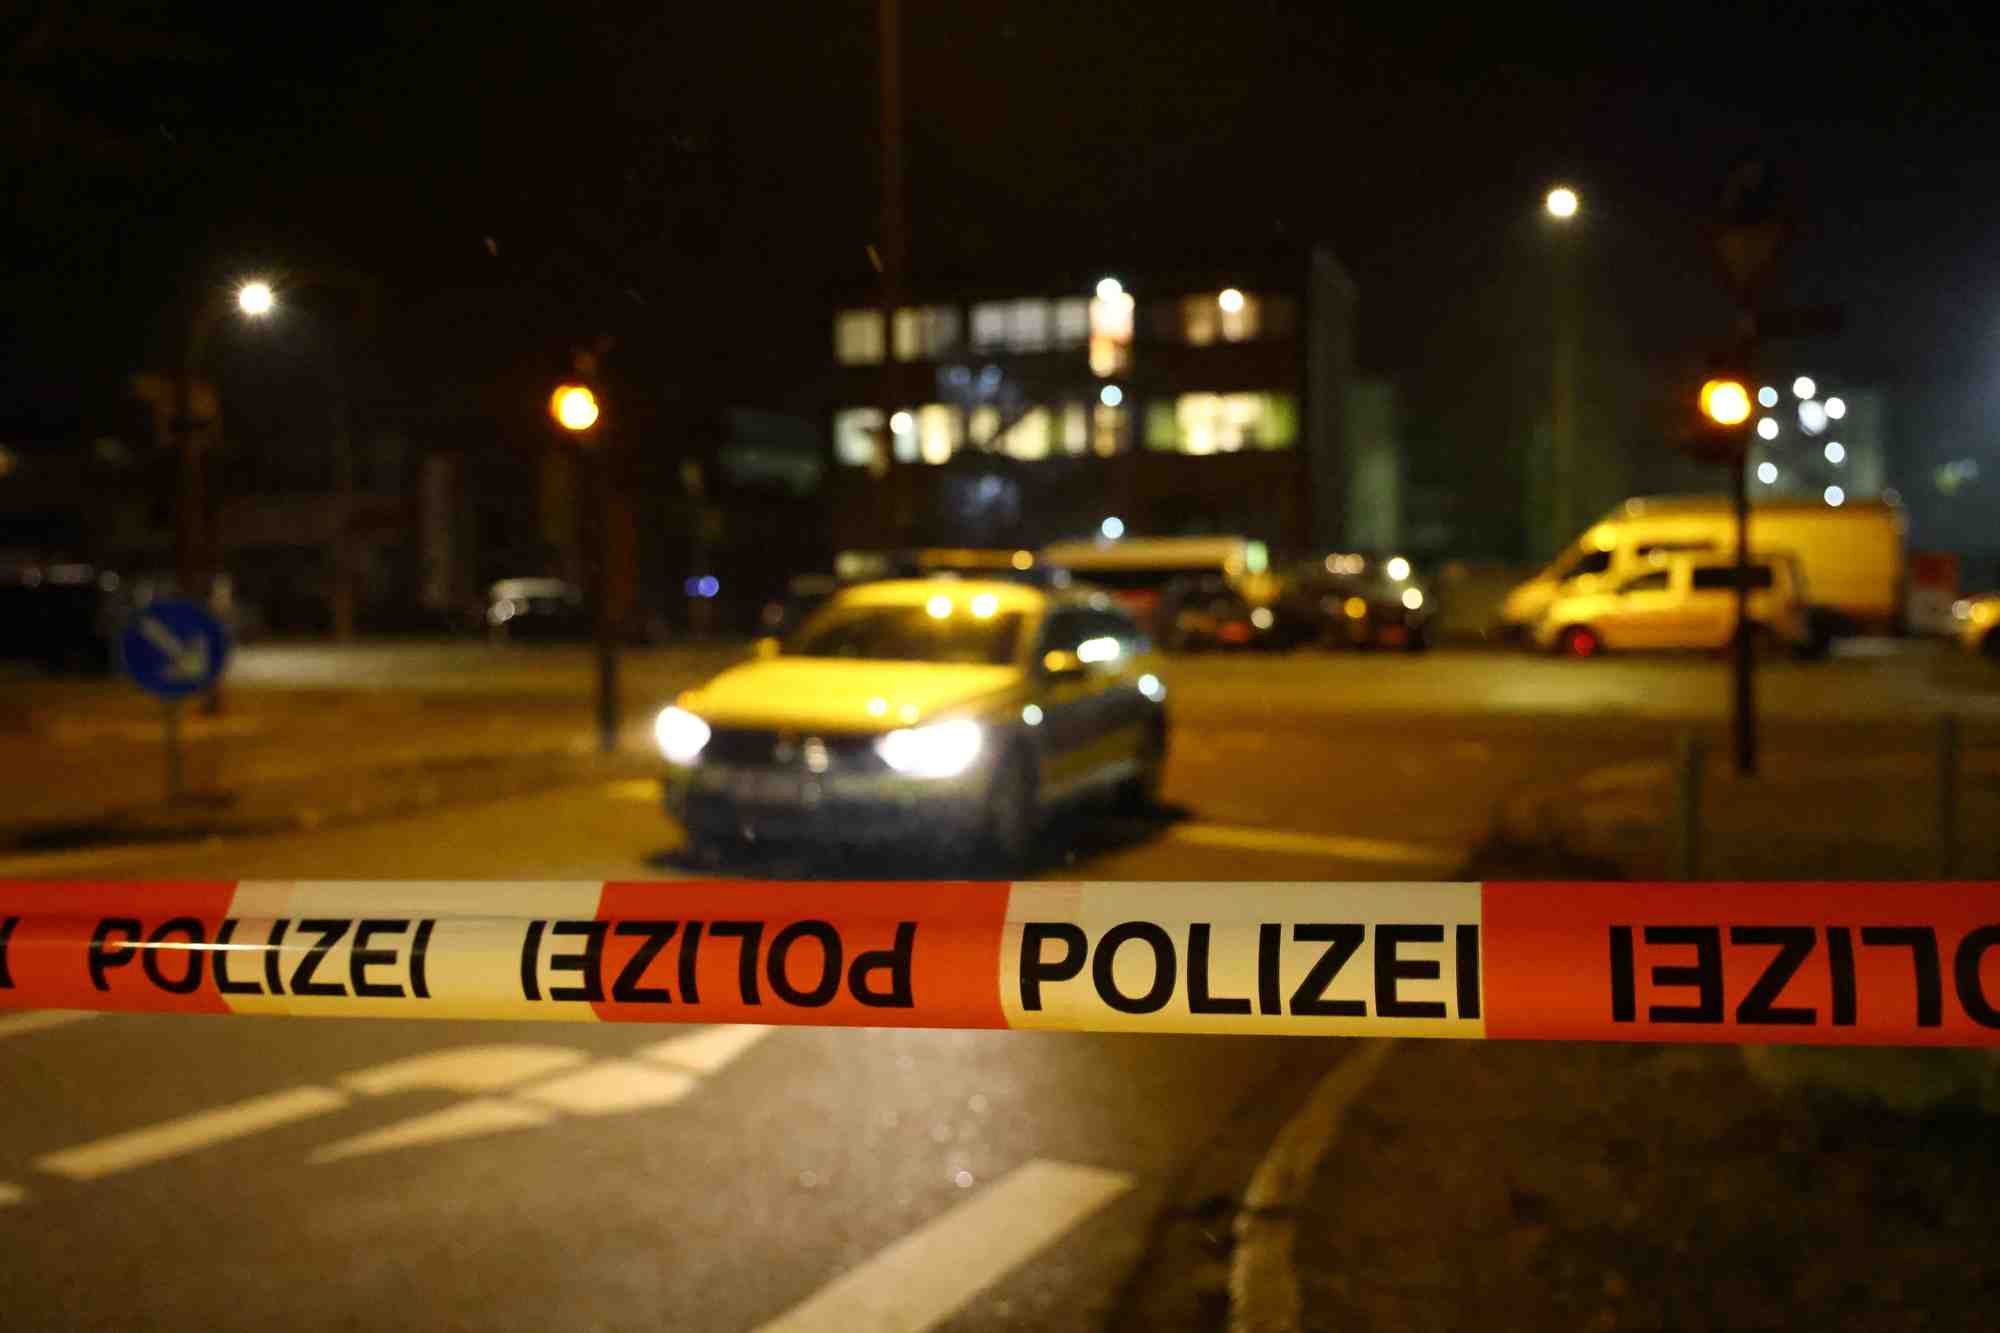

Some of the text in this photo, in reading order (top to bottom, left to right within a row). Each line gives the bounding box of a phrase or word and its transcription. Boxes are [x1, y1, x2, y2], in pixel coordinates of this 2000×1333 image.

[89, 916, 435, 998] POLIZEI
[521, 919, 916, 1009] POLIZEI
[1020, 921, 1479, 1019] POLIZEI
